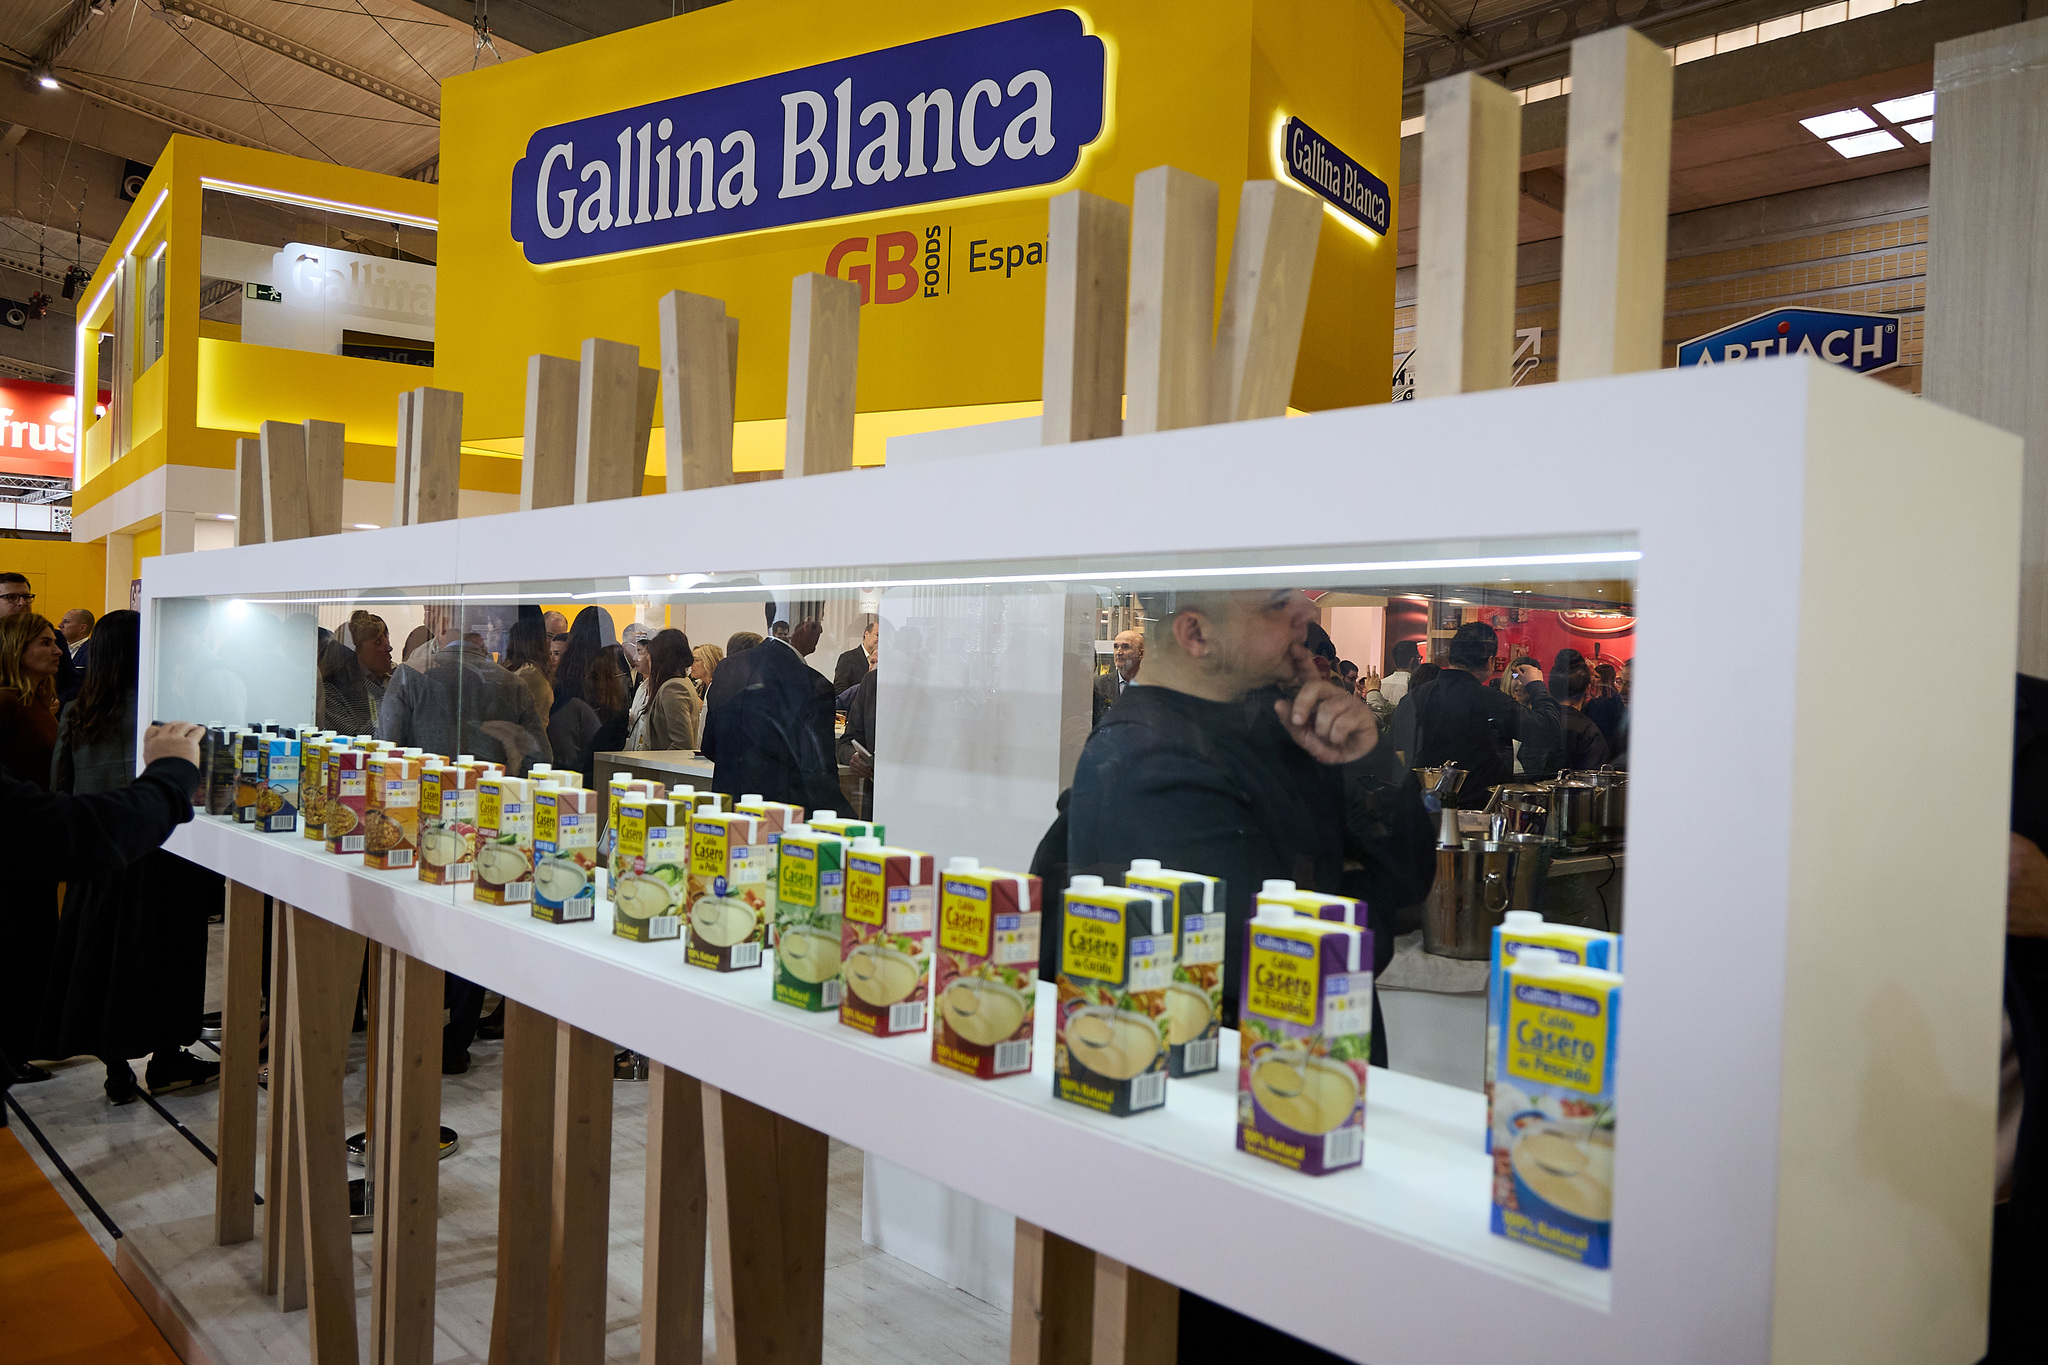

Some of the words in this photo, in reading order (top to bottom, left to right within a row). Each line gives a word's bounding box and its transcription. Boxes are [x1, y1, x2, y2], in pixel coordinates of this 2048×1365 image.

[536, 118, 759, 240] Gallina
[777, 69, 1056, 199] Blanca
[1293, 128, 1341, 197] Gallina
[1343, 163, 1386, 227] Blanca
[825, 231, 919, 307] GB
[924, 225, 941, 298] FOODS
[969, 233, 1049, 278] Espa
[480, 801, 498, 815] Casero
[536, 812, 555, 828] Casero
[621, 825, 642, 840] Casero
[703, 836, 717, 846] Caldo
[694, 842, 723, 862] Casero
[705, 862, 718, 873] Pollo
[783, 865, 813, 888] Casero
[849, 881, 879, 904] Casero
[945, 906, 985, 933] Casero
[1069, 929, 1118, 959] Casero
[1256, 964, 1311, 999] Casero
[1517, 1019, 1595, 1062] Casero
